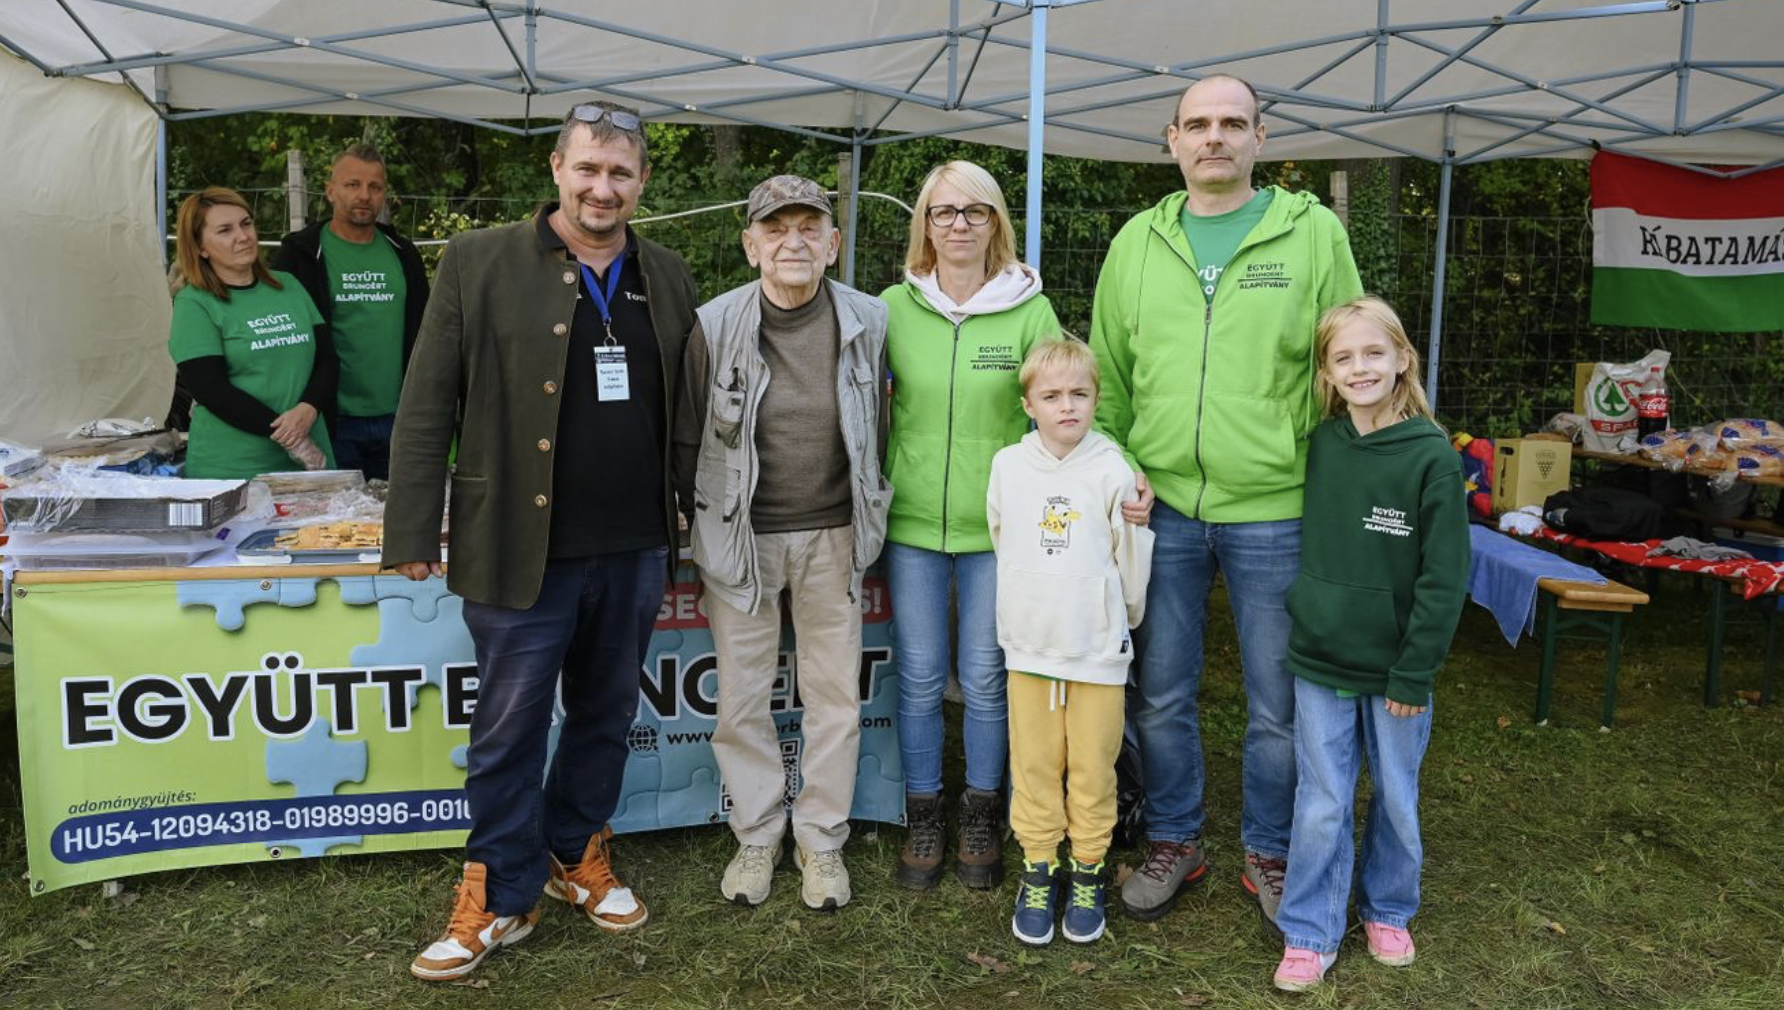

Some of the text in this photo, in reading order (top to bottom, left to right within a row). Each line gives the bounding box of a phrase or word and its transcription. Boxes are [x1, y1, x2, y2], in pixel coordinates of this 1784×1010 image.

[1247, 261, 1285, 272] EGYÜTT
[342, 271, 385, 282] EGYÜTT
[1239, 280, 1289, 290] ALAPÍTVÁNY
[335, 292, 395, 302] ALAPÍTVÁNY
[247, 313, 291, 329] EGYÜTT
[250, 333, 309, 351] ALAPÍTVÁNY
[64, 654, 423, 746] EGYÜTT
